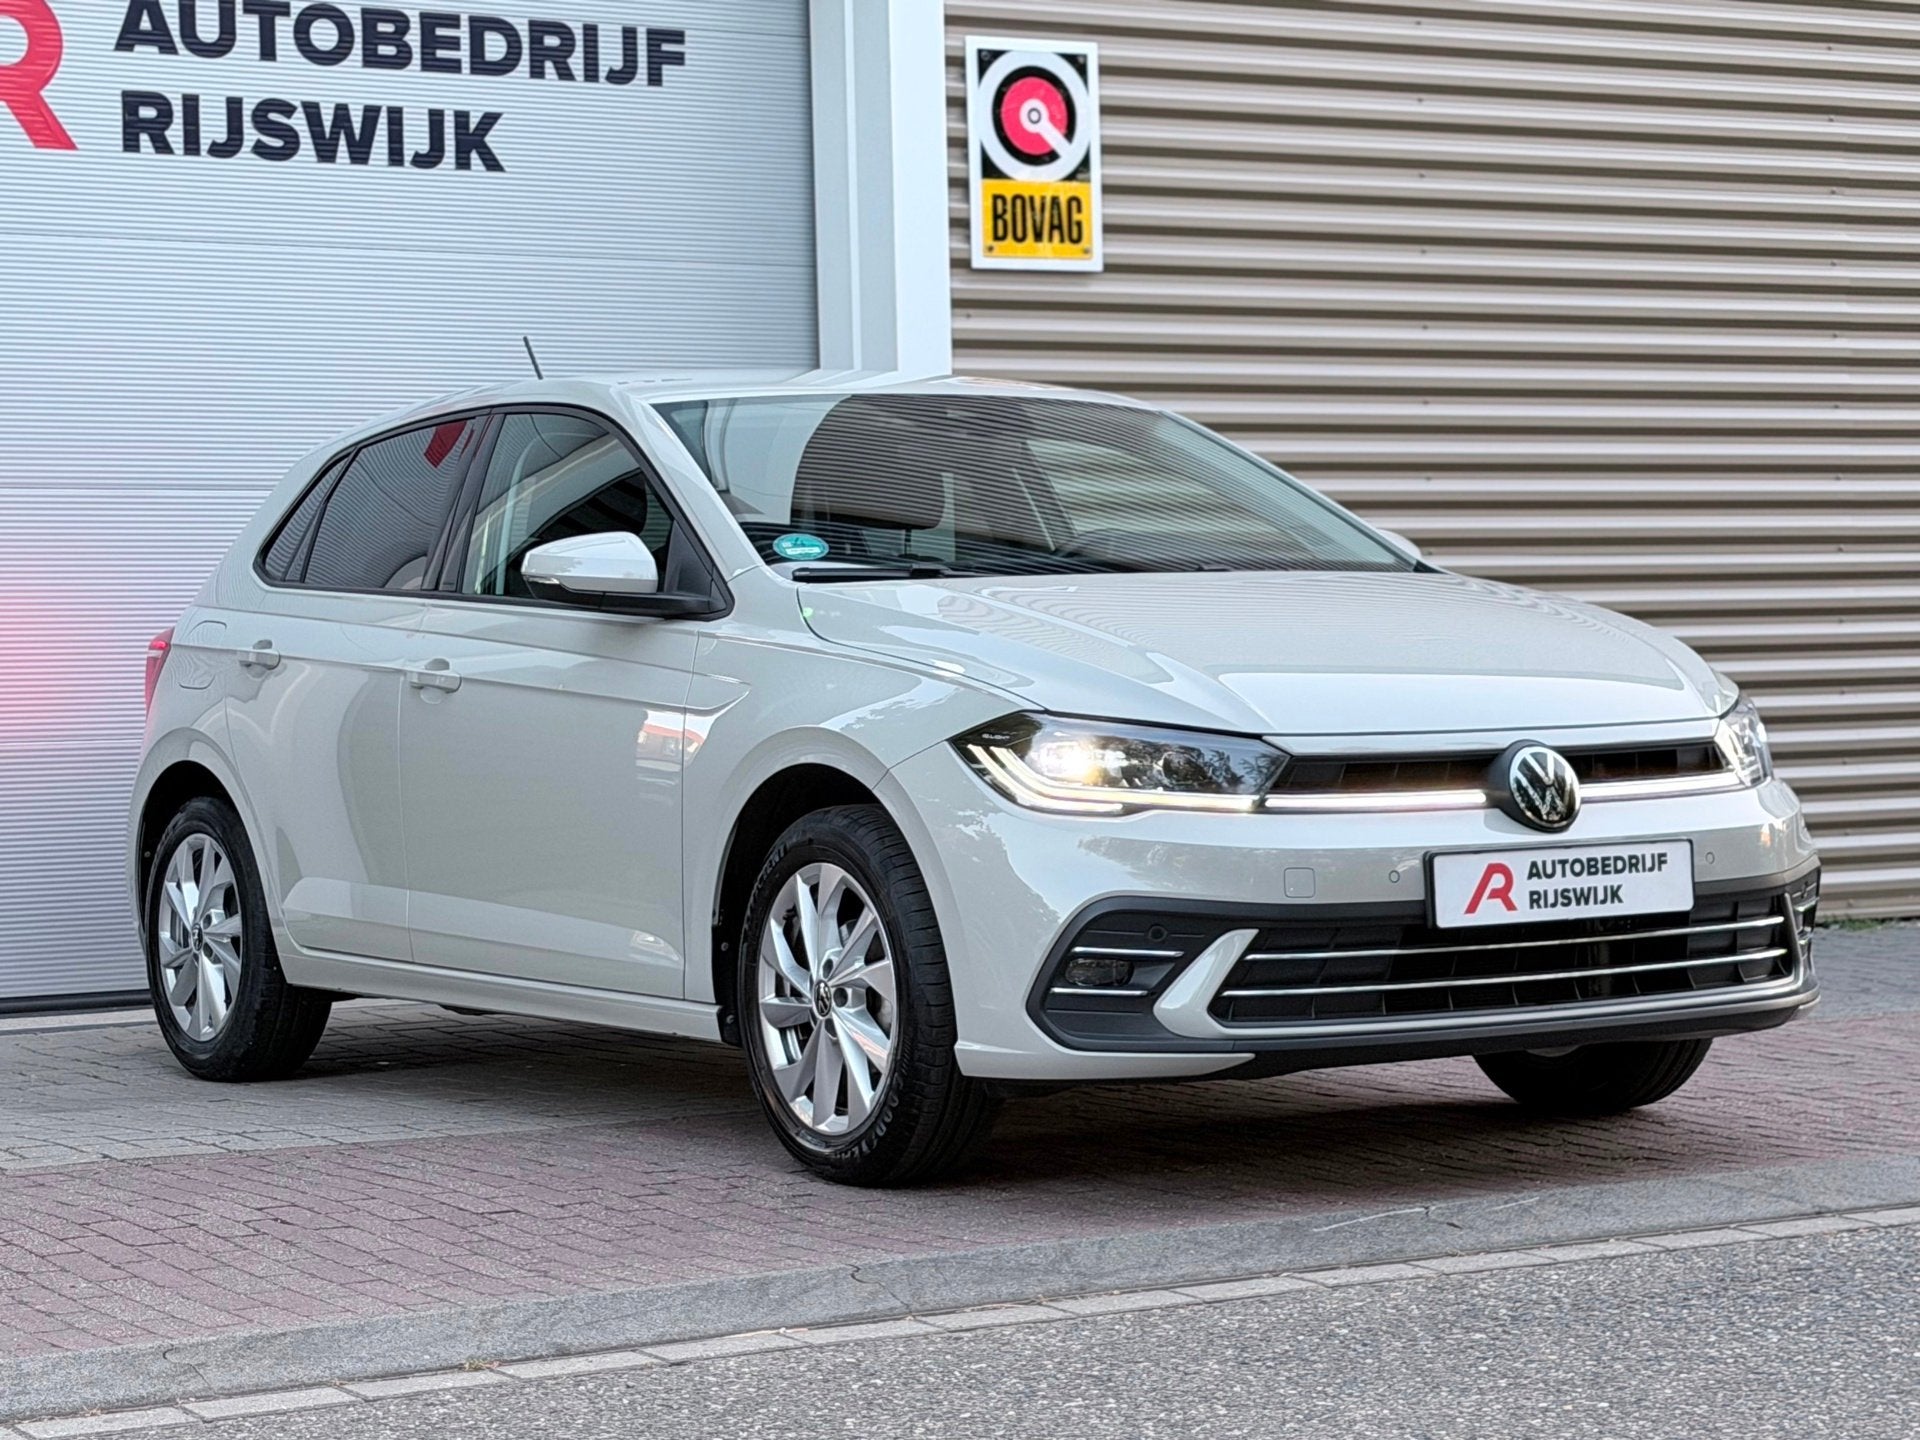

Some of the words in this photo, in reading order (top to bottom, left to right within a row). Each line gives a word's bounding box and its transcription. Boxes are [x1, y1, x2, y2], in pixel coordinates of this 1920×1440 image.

[114, 0, 687, 88] AUTOBEDRIJF
[121, 89, 507, 173] RIJSWIJK
[991, 193, 1084, 245] BOVAG
[1526, 852, 1669, 881] AUTOBEDRIJF
[1528, 883, 1625, 910] RIJSWIJK
